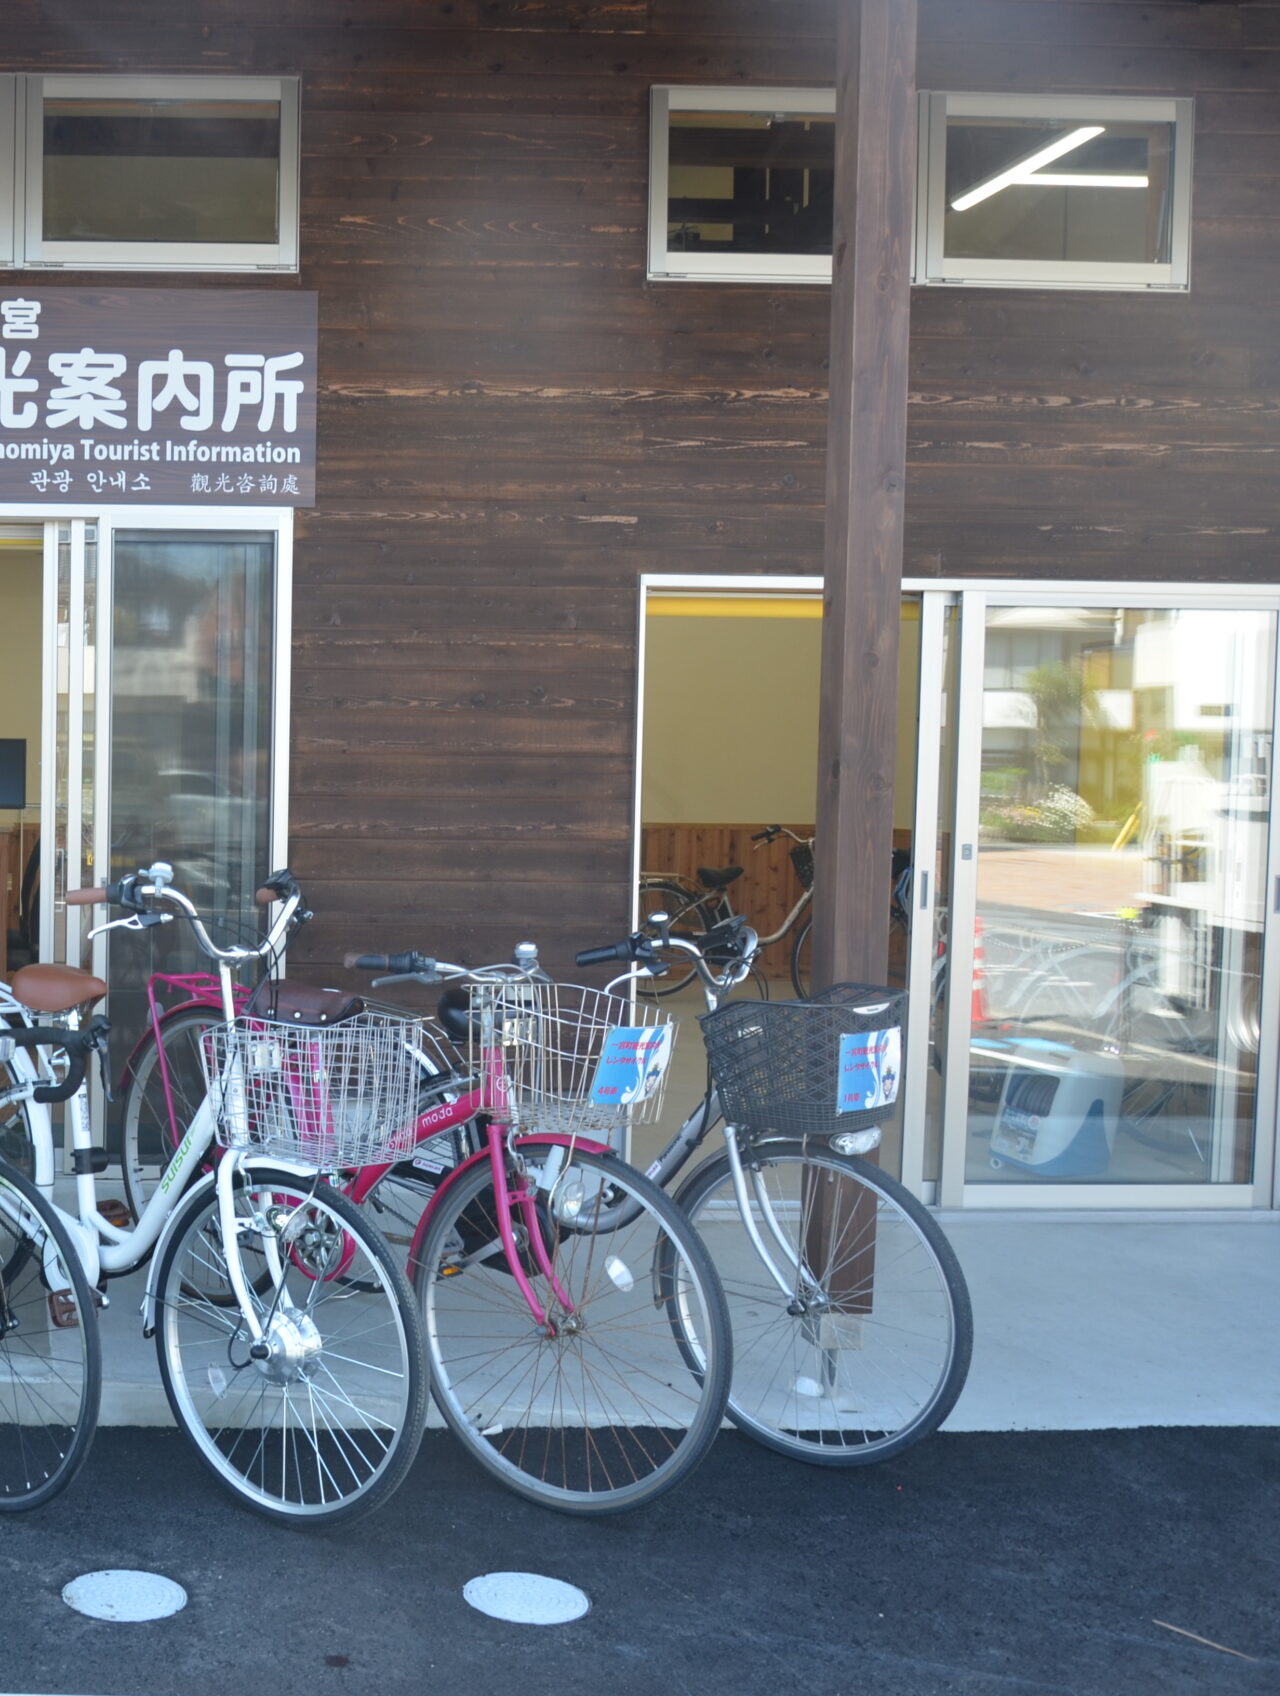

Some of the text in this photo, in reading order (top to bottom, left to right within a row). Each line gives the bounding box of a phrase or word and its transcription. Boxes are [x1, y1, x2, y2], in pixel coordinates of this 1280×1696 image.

[80, 438, 161, 461] Tourist
[166, 439, 301, 464] Information
[29, 469, 152, 494] 관광 안내소
[422, 1107, 454, 1128] moda
